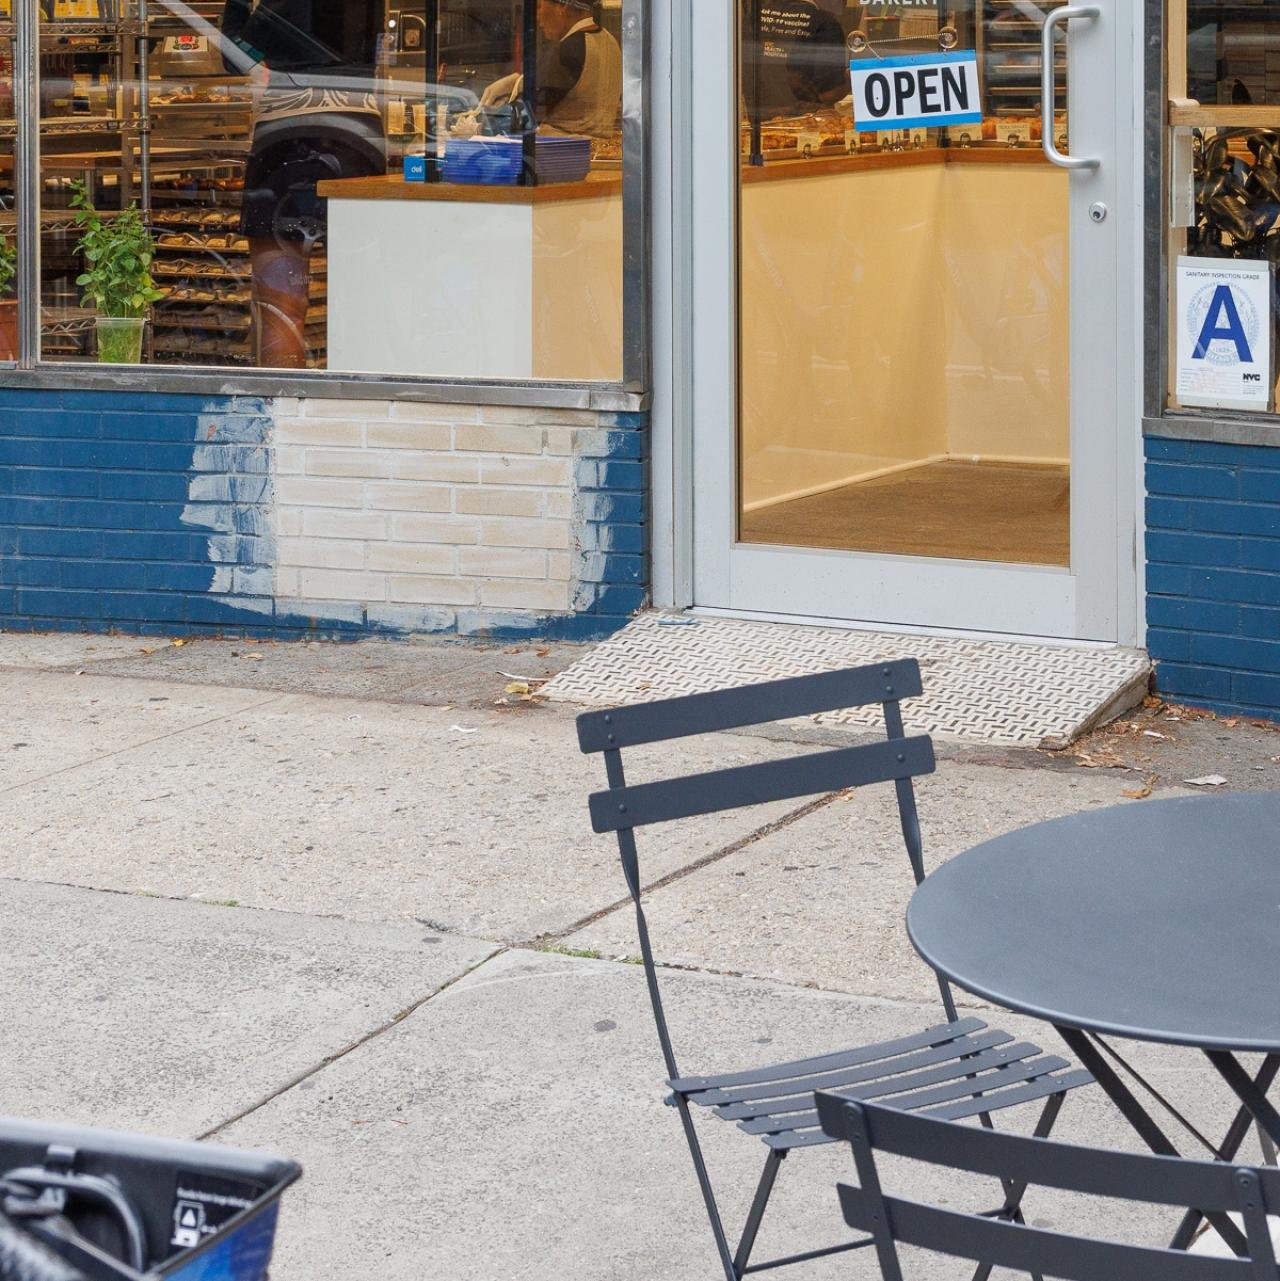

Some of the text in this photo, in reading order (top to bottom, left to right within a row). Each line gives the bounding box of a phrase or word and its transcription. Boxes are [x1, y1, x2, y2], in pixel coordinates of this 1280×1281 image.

[864, 65, 970, 118] OPEN
[1191, 284, 1254, 363] A
[1242, 373, 1261, 381] NYC
